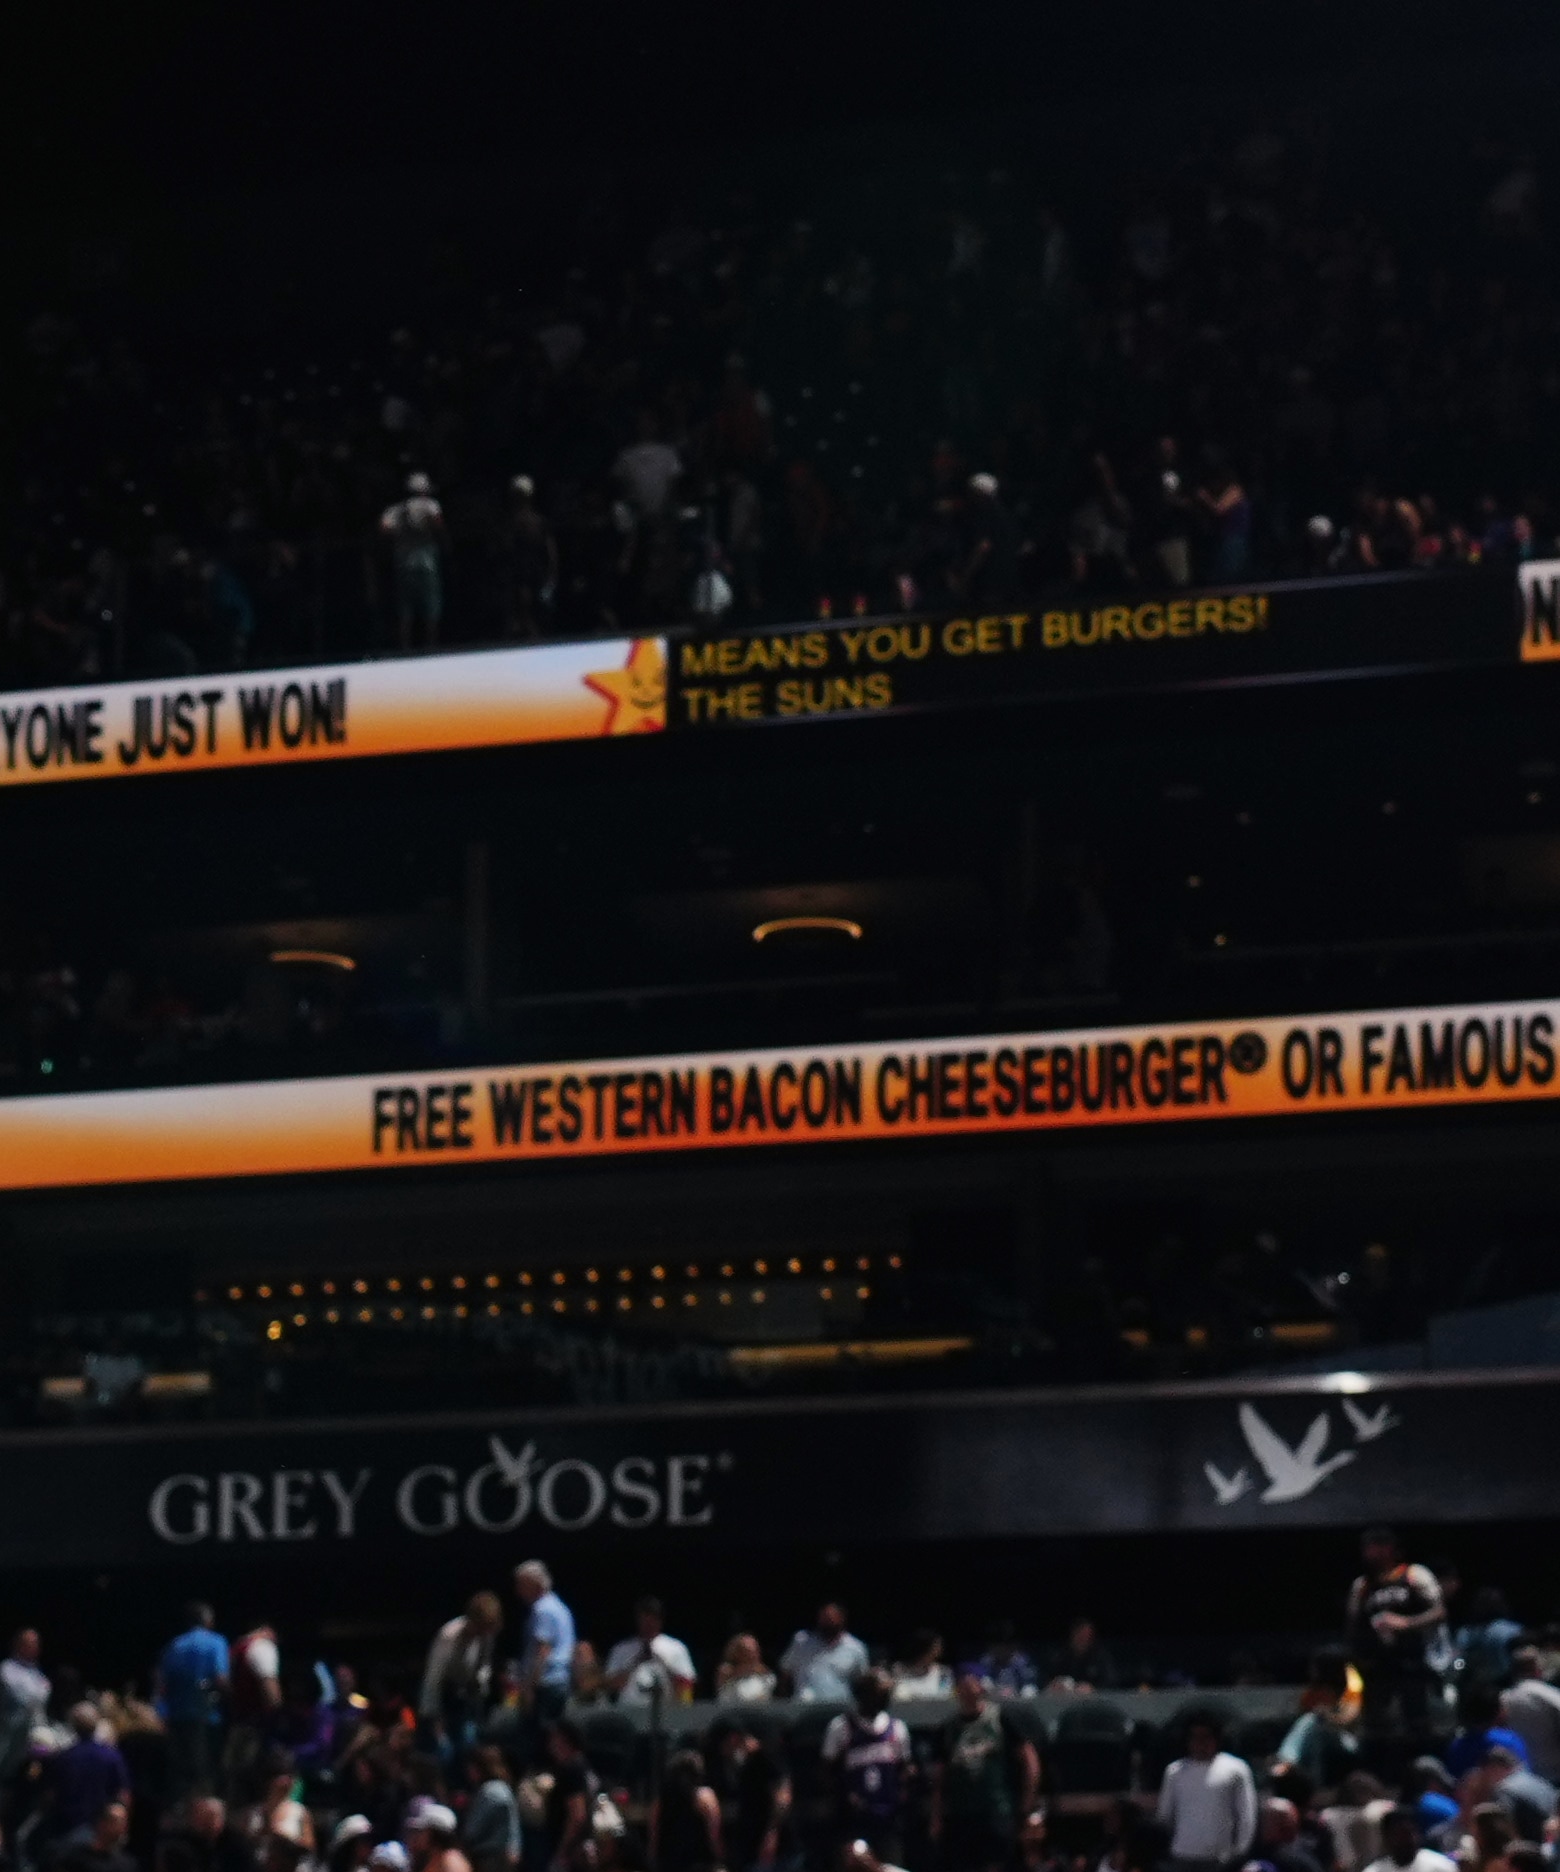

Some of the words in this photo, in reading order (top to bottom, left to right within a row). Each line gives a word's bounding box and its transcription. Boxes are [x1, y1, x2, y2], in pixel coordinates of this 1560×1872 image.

[680, 634, 829, 678] MEANS
[840, 624, 931, 663] YOU
[942, 613, 1029, 657] GET
[1041, 595, 1269, 649] BURGERS!
[117, 690, 225, 765] JUST
[238, 677, 347, 751] WON!
[682, 683, 762, 724] THE
[776, 672, 894, 717] SUNS
[374, 1081, 475, 1153] FREE
[487, 1064, 698, 1150] WESTERN
[706, 1057, 864, 1137] BACON
[1281, 1026, 1346, 1102] OR
[1359, 1011, 1557, 1095] FAMOUS
[146, 1466, 372, 1545] GREY
[394, 1454, 713, 1537] GOOSE
